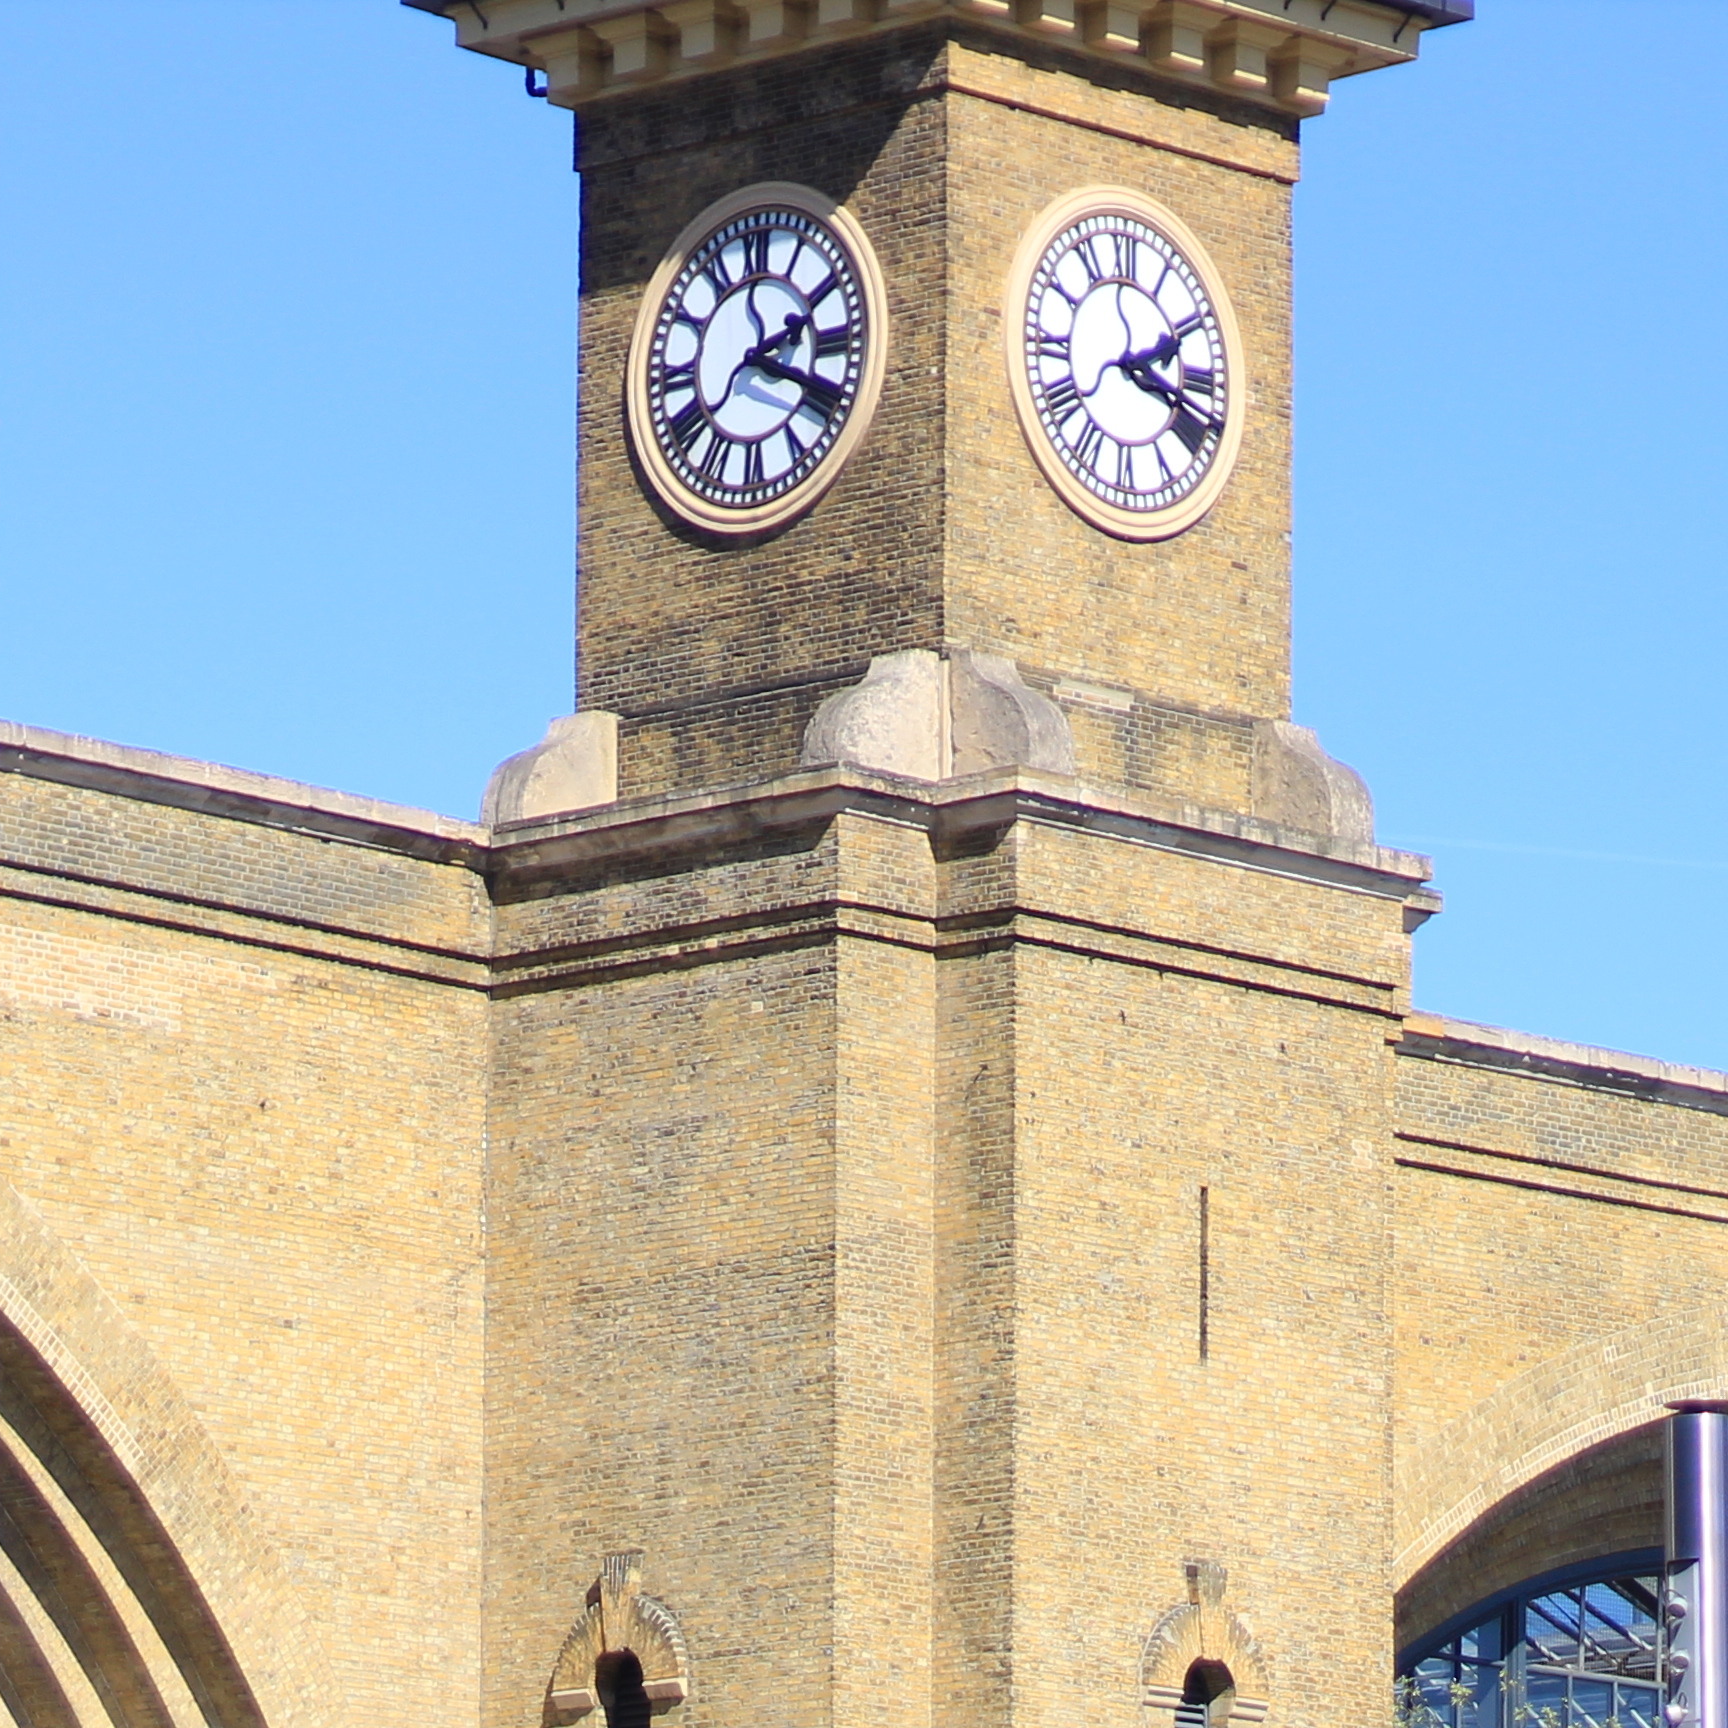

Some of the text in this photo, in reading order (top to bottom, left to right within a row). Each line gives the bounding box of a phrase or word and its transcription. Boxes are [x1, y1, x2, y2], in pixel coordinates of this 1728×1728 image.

[785, 236, 805, 279] I
[1075, 238, 1103, 283] XI
[1112, 234, 1137, 280] XII
[1049, 273, 1081, 309] X
[1153, 261, 1171, 298] I
[1038, 327, 1070, 361] IX
[1173, 310, 1203, 340] II
[1183, 363, 1213, 396] III
[1075, 419, 1105, 470] VII
[1117, 445, 1136, 488] VI
